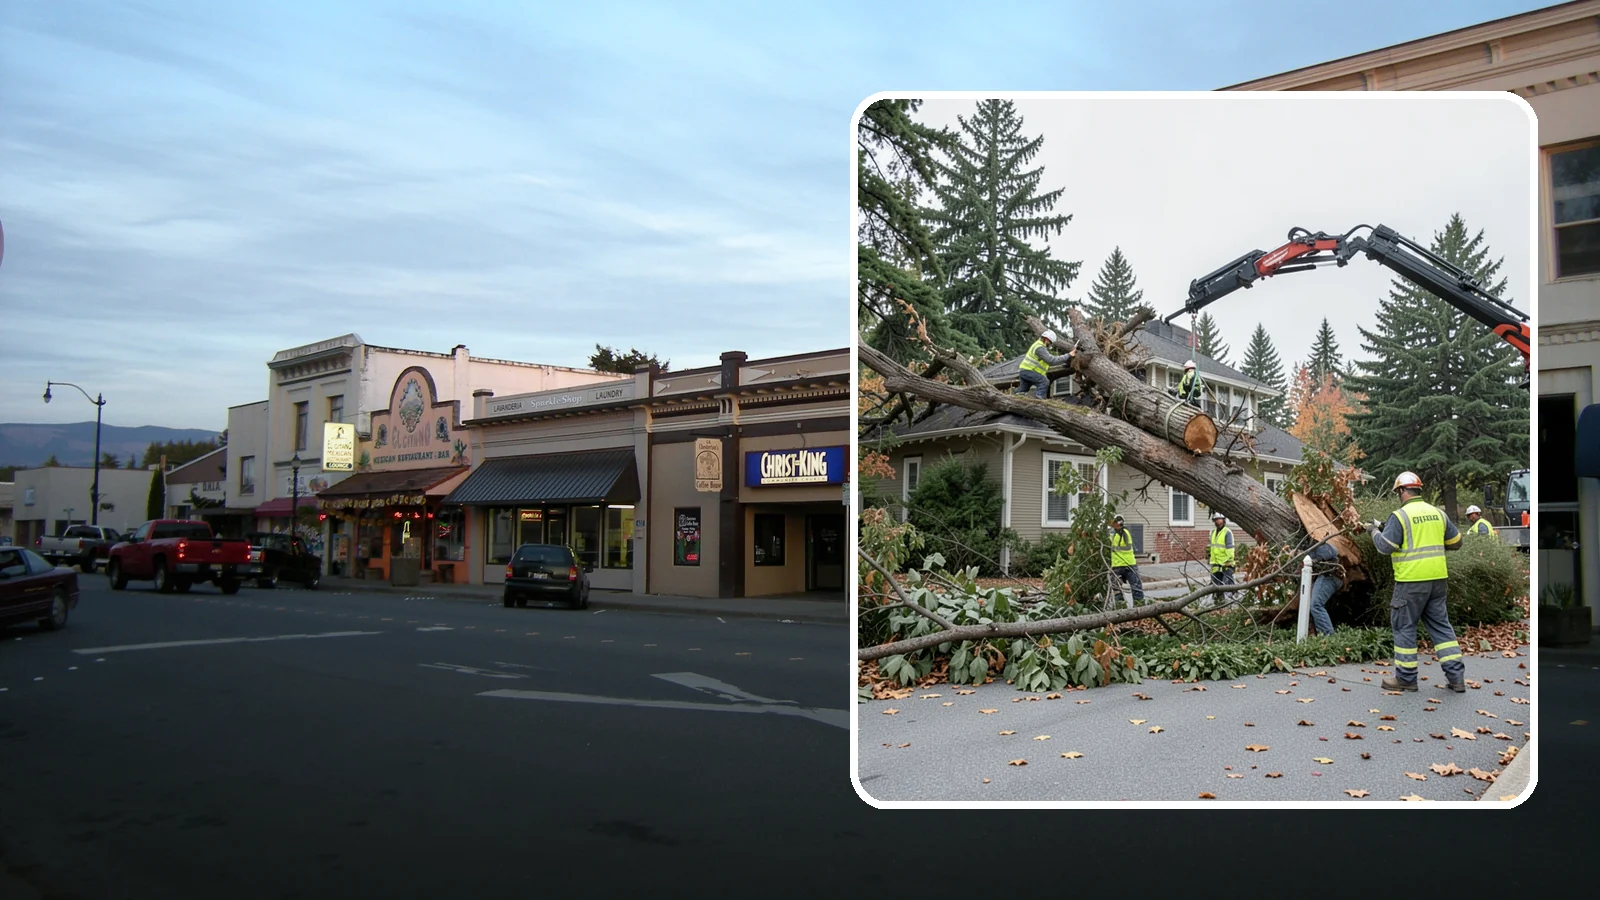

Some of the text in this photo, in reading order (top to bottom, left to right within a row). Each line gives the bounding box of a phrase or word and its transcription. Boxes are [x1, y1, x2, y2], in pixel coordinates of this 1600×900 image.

[562, 394, 582, 405] Shop
[595, 389, 623, 400] LAUNDRY
[493, 402, 522, 413] LAVANDERIA
[373, 454, 395, 464] MEXICAN
[397, 452, 433, 462] RESTAURANT
[437, 450, 450, 458] BAR
[761, 450, 827, 478] CHRIST KING
[696, 480, 722, 488] Coffee House
